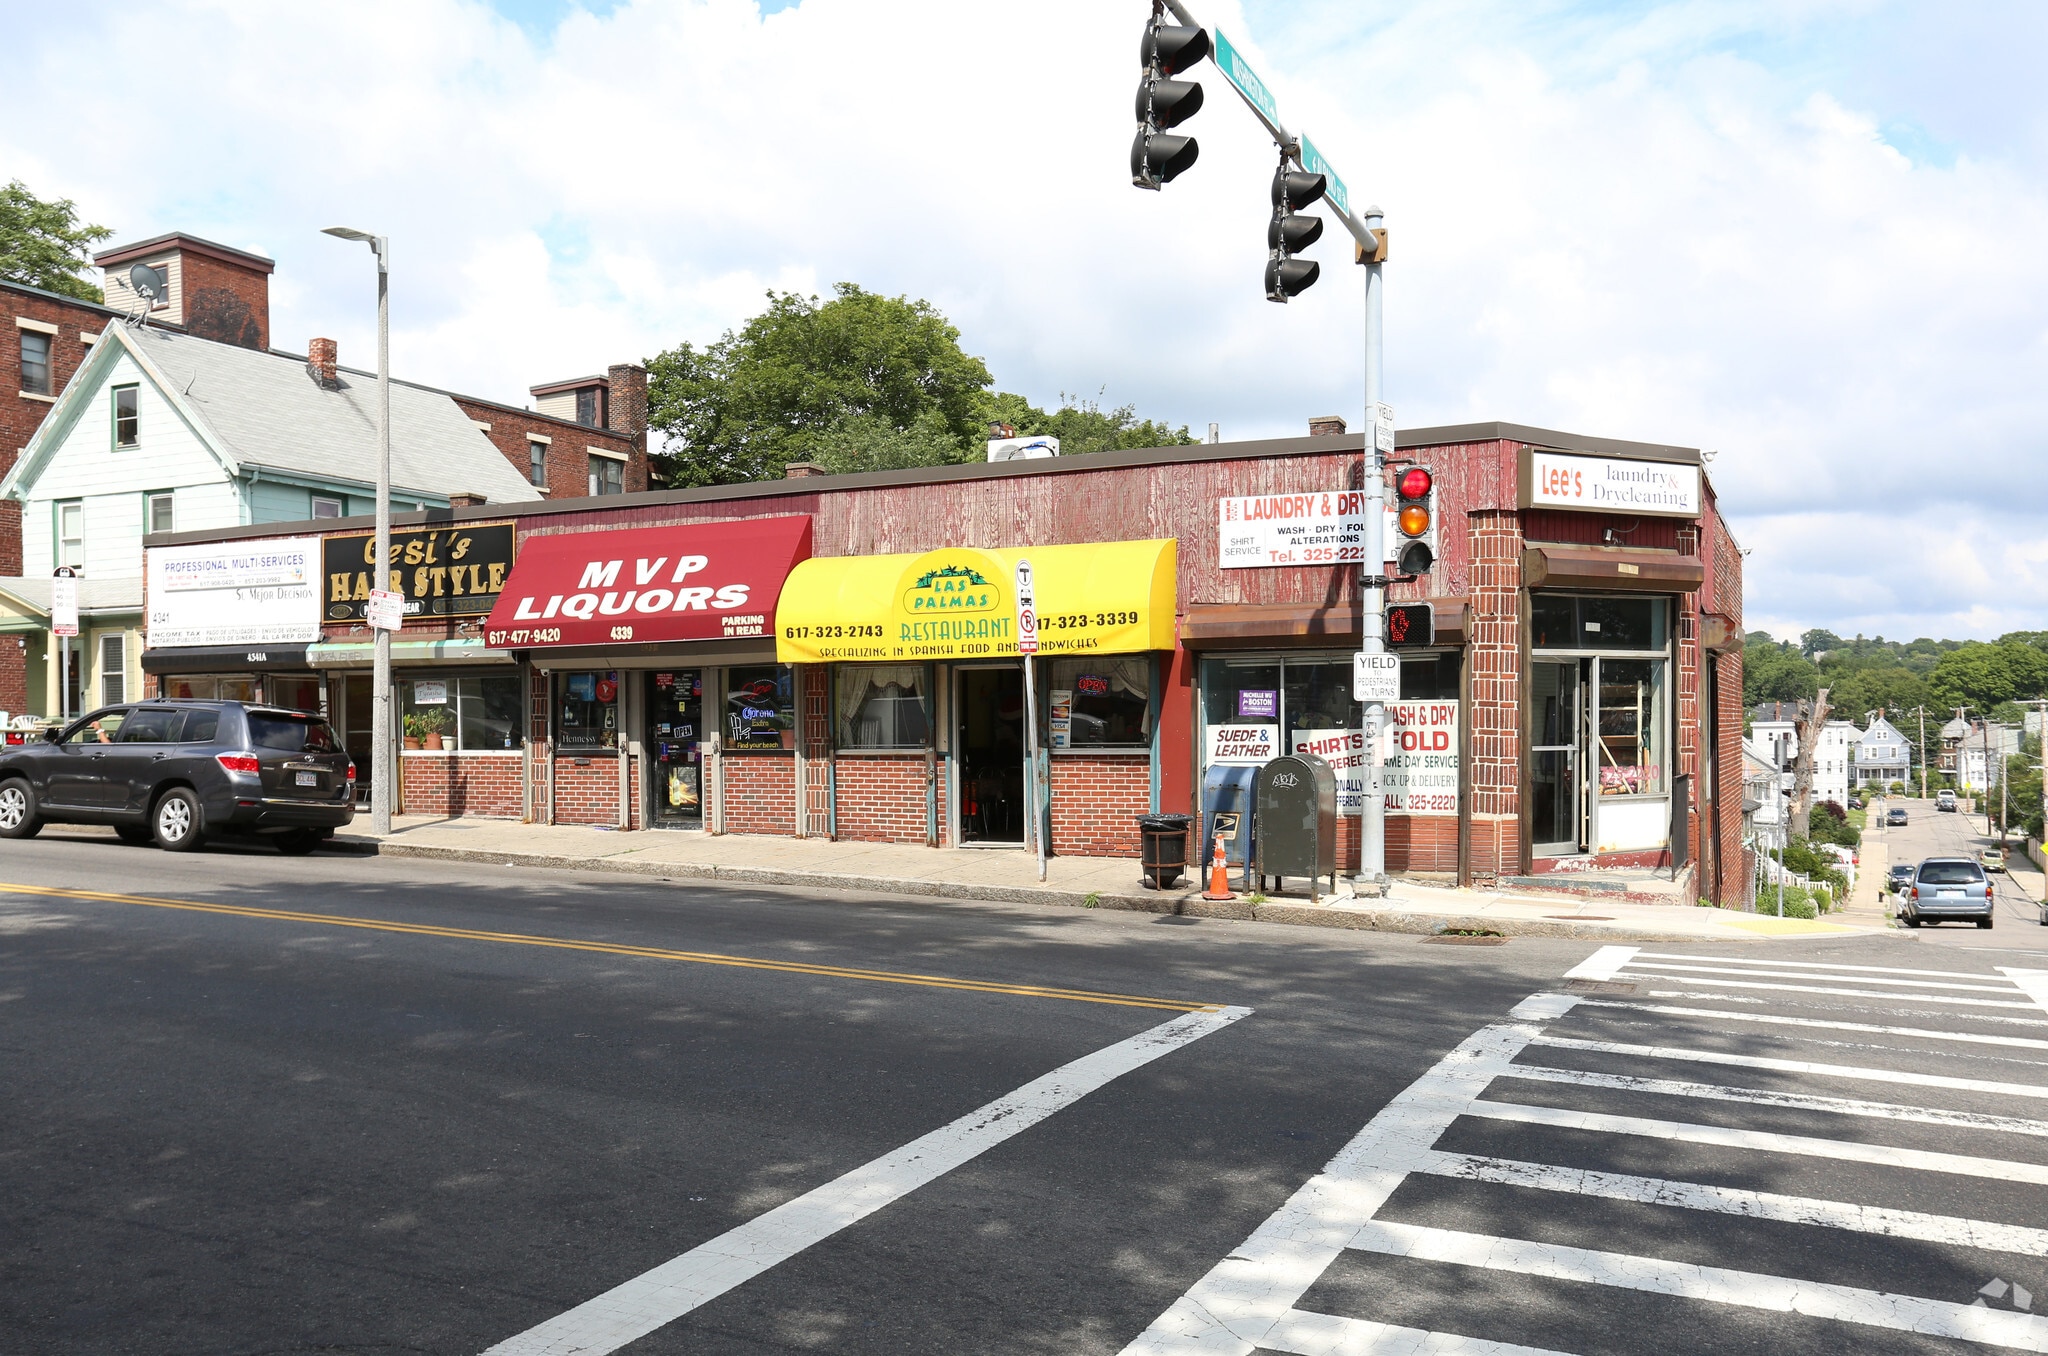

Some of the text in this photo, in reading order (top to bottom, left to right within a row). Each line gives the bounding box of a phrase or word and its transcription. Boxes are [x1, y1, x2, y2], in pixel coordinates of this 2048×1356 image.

[1231, 51, 1264, 108] WASHINGTON
[1378, 405, 1393, 421] YIELD
[1542, 464, 1582, 497] Lee's
[1606, 464, 1667, 488] laundry
[1593, 484, 1688, 509] Drycleaning
[1243, 495, 1315, 520] LAUNDRY
[1320, 493, 1331, 517] &
[1278, 523, 1365, 535] WASH DRY FOL
[1230, 537, 1255, 546] SHIRT
[1290, 534, 1360, 545] ALTERATIONS
[1224, 546, 1261, 556] SERVICE
[1269, 546, 1365, 562] Tel. 325-222
[165, 560, 228, 573] PROFESSIONAL
[231, 554, 304, 569] MULTI-SERVICES
[331, 563, 506, 601] HAR STYLE
[934, 580, 967, 592] LAS
[434, 599, 496, 613] 617-323-04
[513, 584, 751, 621] LIQUORS
[914, 593, 989, 609] PALMAS
[721, 615, 765, 626] PARKING
[1036, 611, 1139, 631] 17-323-3339
[610, 626, 633, 640] 4339
[723, 625, 763, 636] IN REAR
[786, 625, 884, 639] 617-323-2743
[899, 618, 1011, 641] RESTAURANT
[819, 637, 1098, 657] SPECIALIZING IN SPANISH FOOD AND NDWICHES
[246, 652, 267, 662] 4341A
[1360, 657, 1396, 669] YIELD
[1078, 679, 1107, 692] OPEN
[1357, 677, 1397, 686] PEDESTRIANS
[1371, 687, 1396, 697] TURNS
[1248, 698, 1272, 706] BOSTON
[742, 706, 774, 720] Corona
[1384, 705, 1455, 726] ASH & DRY
[675, 726, 692, 737] OPEN
[1259, 729, 1269, 742] &
[562, 734, 596, 745] Hennessy
[1296, 733, 1363, 755] SHIRTS
[1214, 744, 1271, 757] LEATHER
[1328, 755, 1363, 771] DERED
[1384, 755, 1458, 768] AME DAY SERVICE
[1384, 774, 1457, 787] ICK UP & DELIVERY
[1336, 795, 1362, 807] FFERENC
[1384, 794, 1456, 810] ALL: 325-2220
